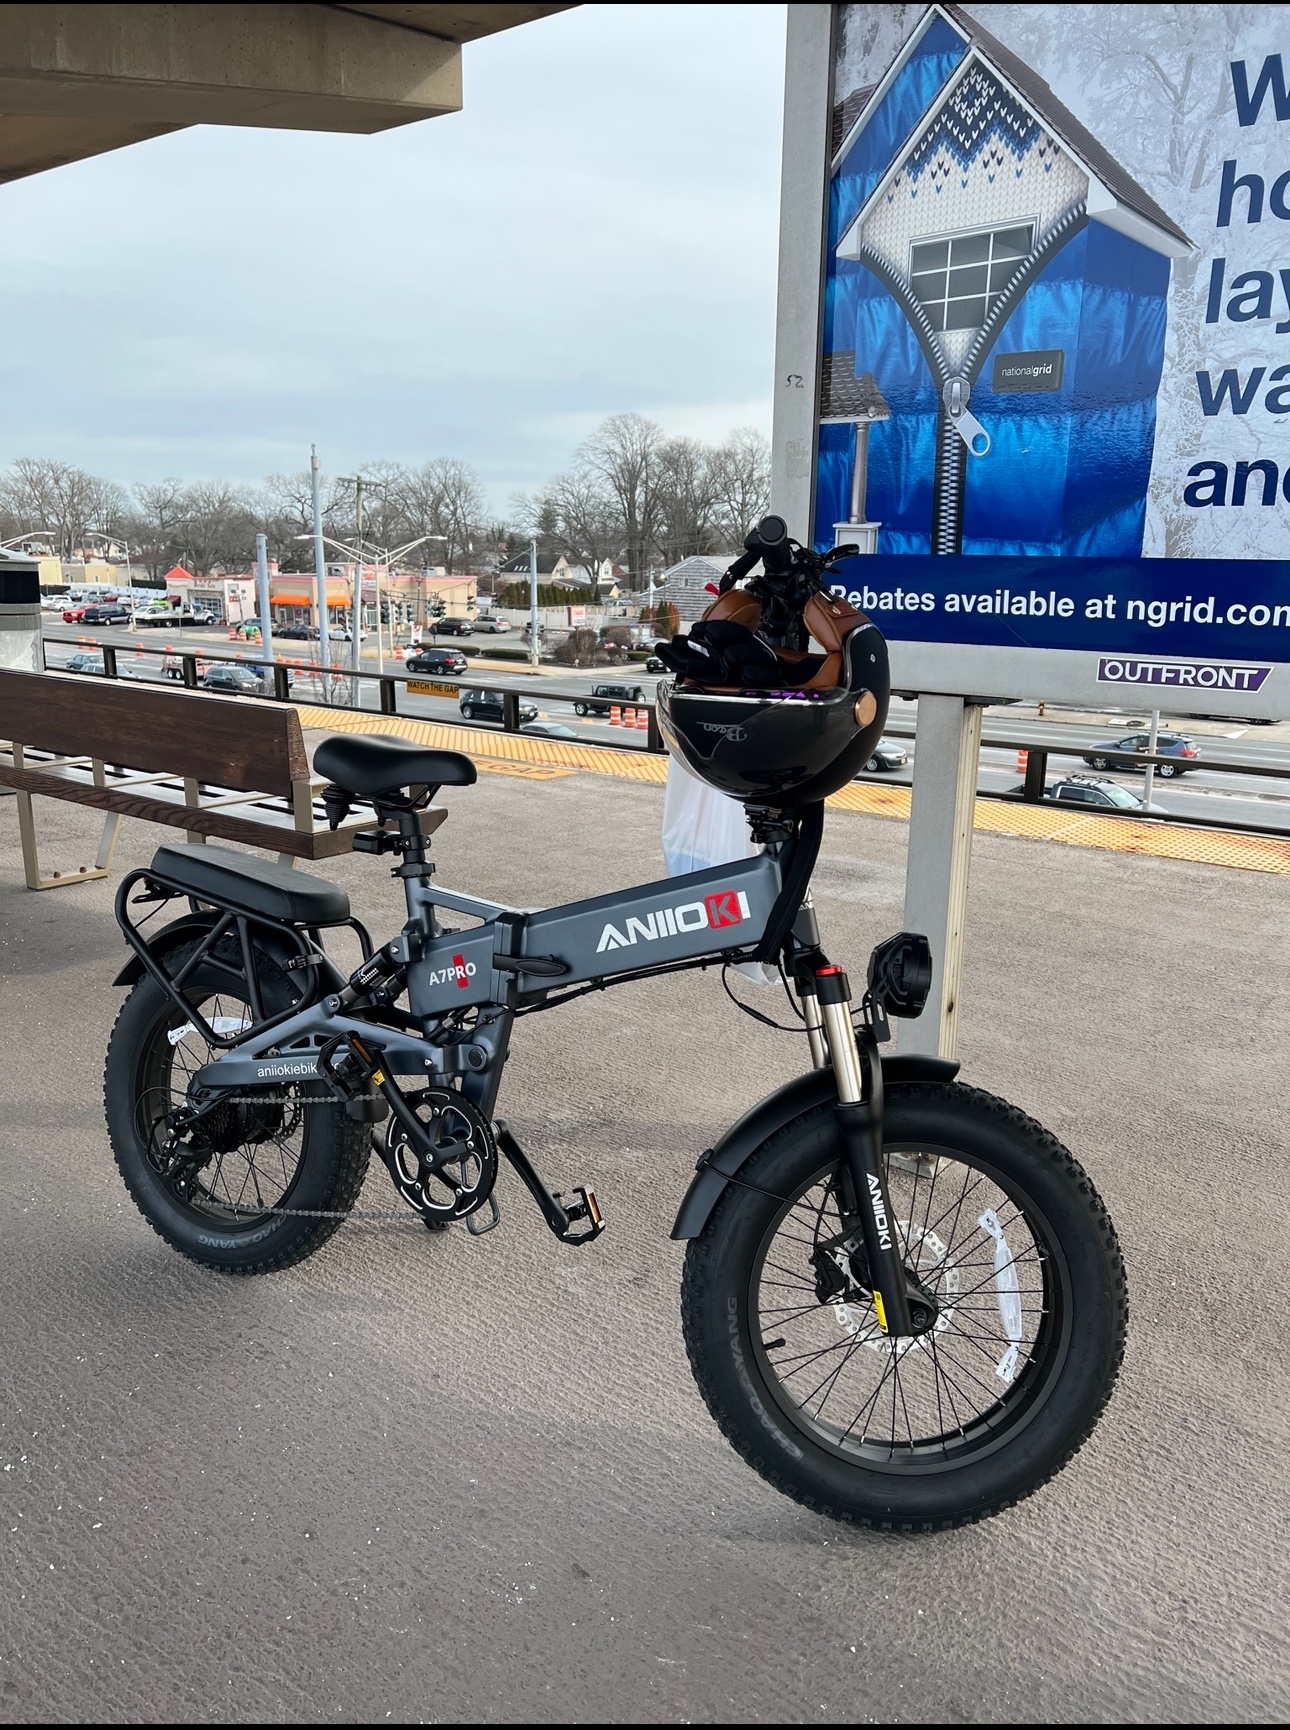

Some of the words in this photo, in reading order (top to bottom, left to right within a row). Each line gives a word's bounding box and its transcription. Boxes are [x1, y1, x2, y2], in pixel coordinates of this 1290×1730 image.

[1001, 363, 1053, 377] nationalgrid
[1183, 459, 1290, 508] an
[944, 589, 1075, 617] available
[1085, 594, 1116, 619] at
[407, 680, 429, 690] WATCH
[430, 682, 443, 692] THE
[444, 684, 459, 693] GAP
[1104, 661, 1259, 688] OUTFRONT
[596, 891, 751, 953] ANIIOKI
[429, 962, 477, 986] A7PRO
[866, 1172, 893, 1251] ANIIOKI
